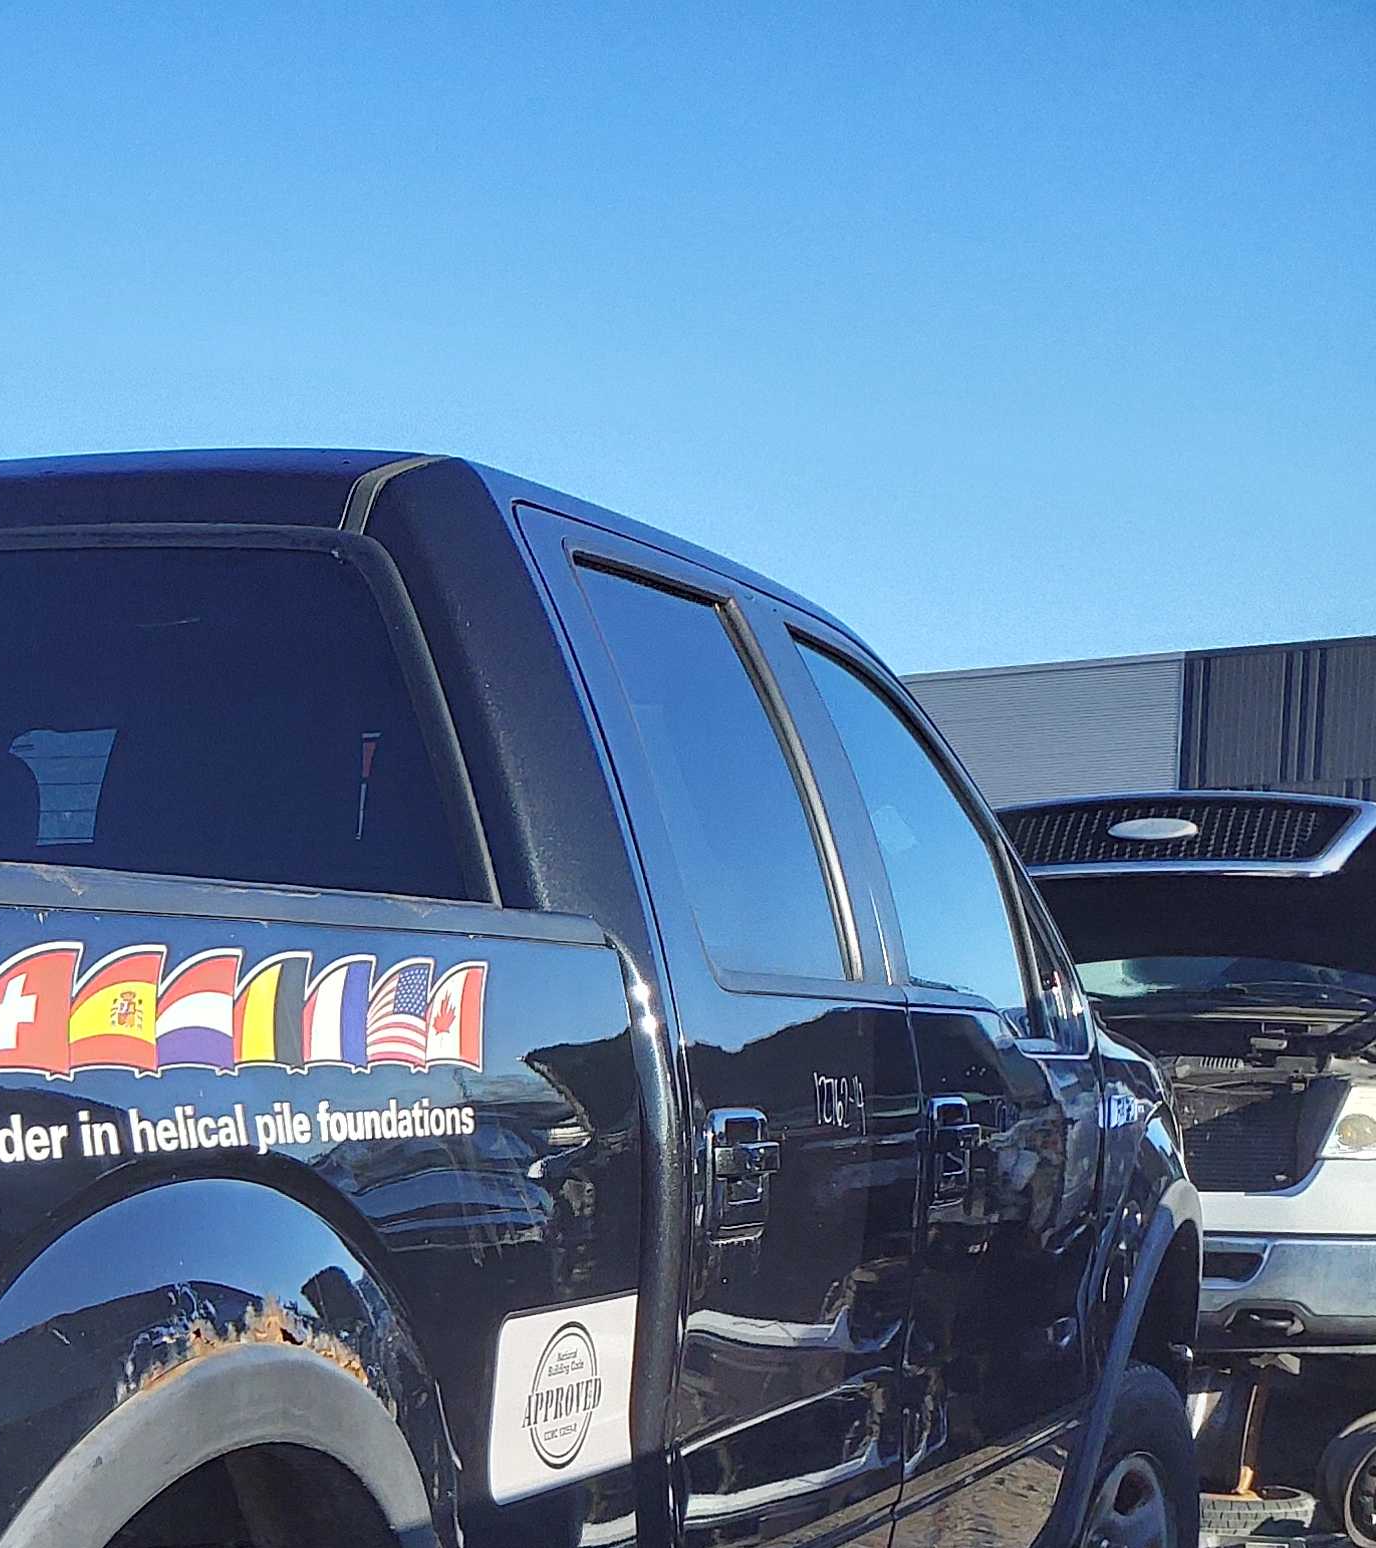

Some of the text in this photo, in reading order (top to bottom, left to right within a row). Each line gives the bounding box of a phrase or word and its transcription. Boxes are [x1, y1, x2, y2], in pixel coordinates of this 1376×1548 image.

[79, 1111, 122, 1158] in
[128, 1104, 250, 1153] helical
[255, 1103, 312, 1155] pile
[317, 1099, 475, 1143] foundations
[522, 1378, 602, 1428] APPROVED
